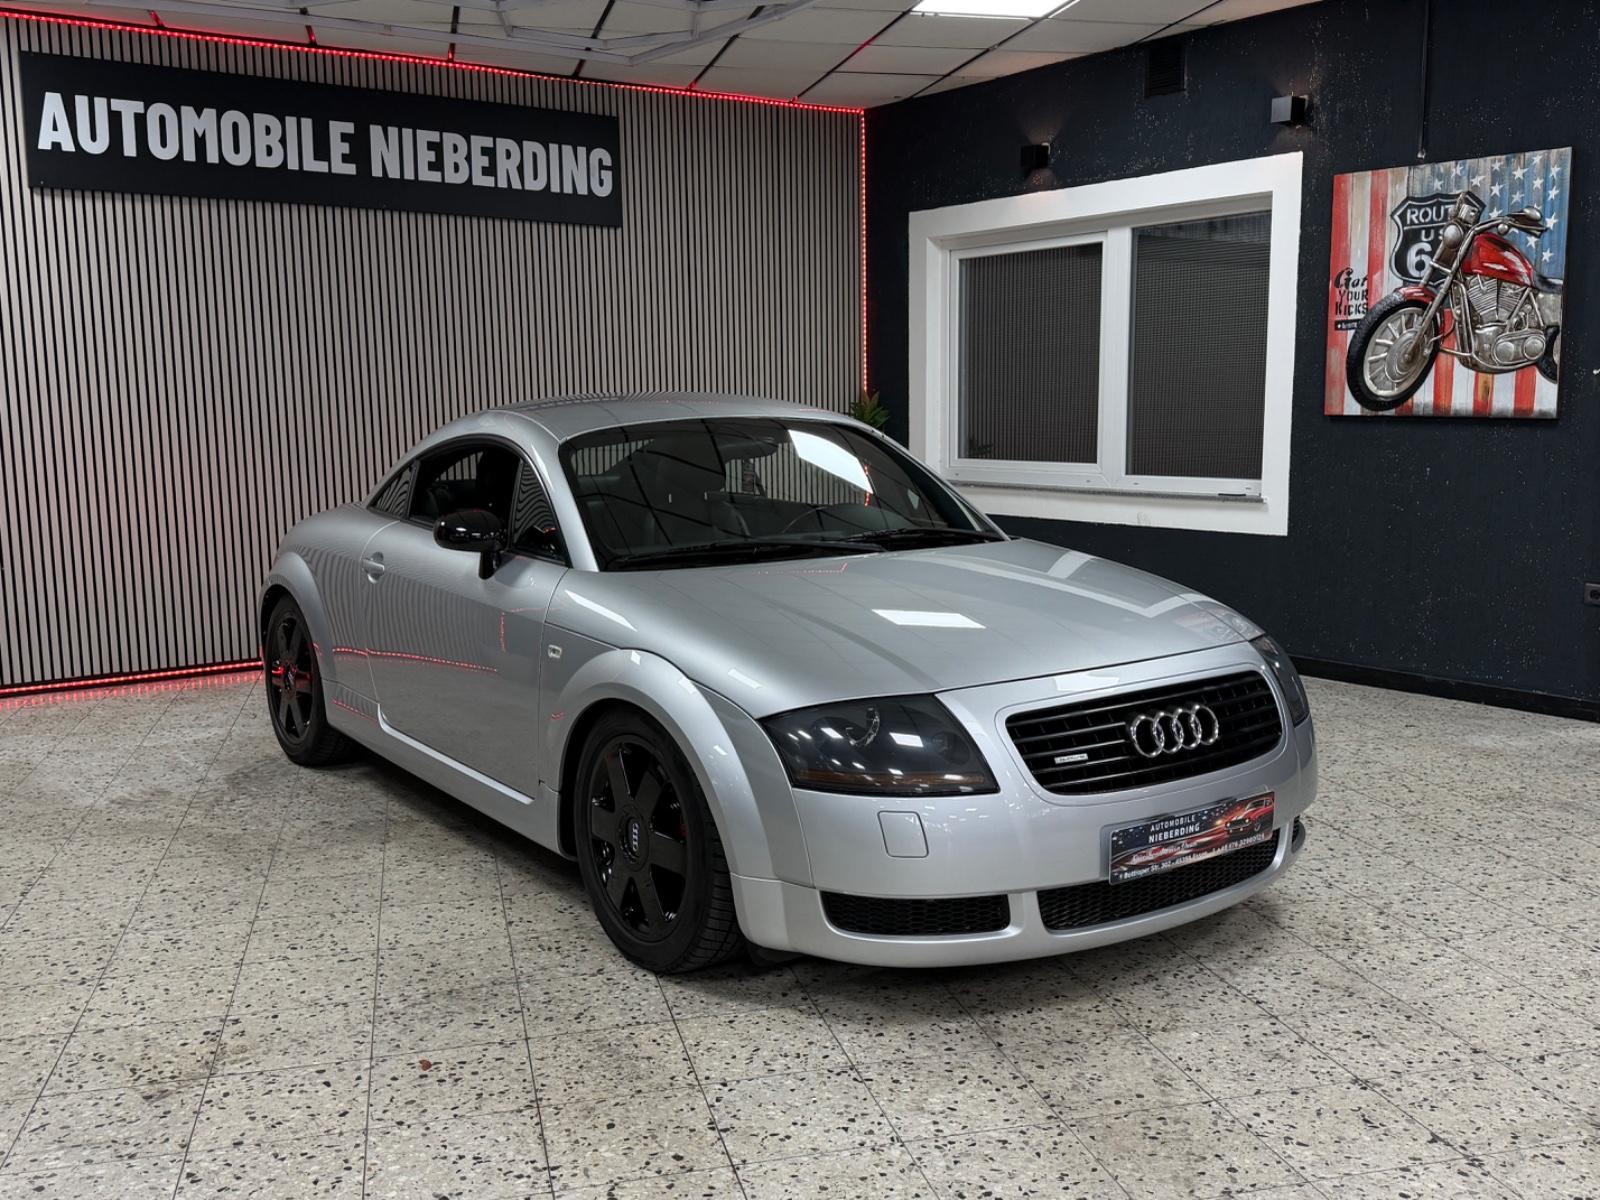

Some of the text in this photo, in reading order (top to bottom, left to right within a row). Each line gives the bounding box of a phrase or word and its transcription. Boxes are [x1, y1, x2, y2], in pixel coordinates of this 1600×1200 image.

[37, 91, 614, 198] AUTOMOBILE NIEBERDING
[1406, 204, 1456, 225] ROUT
[1148, 822, 1201, 844] NIEBERDING
[1150, 814, 1196, 832] AUTOMOBILE
